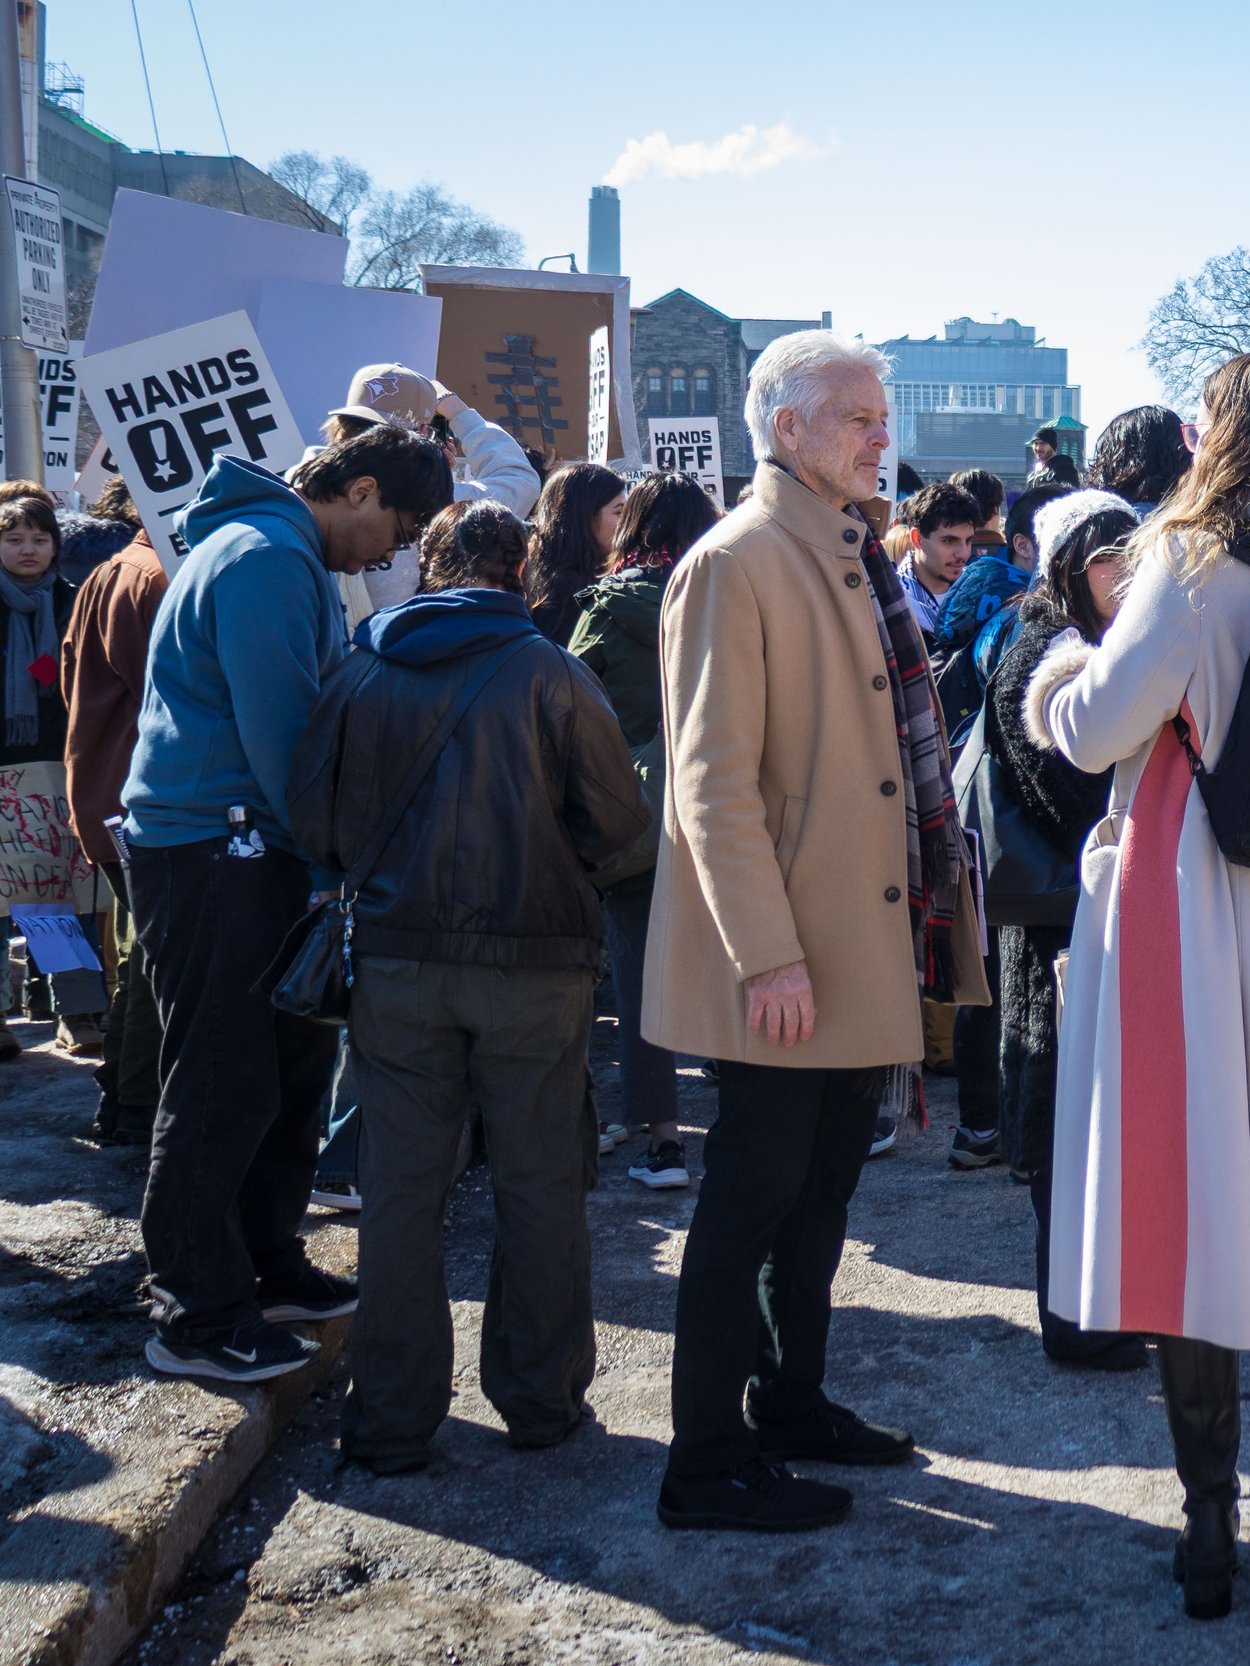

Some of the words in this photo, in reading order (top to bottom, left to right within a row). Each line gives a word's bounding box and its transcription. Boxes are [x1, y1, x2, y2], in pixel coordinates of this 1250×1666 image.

[15, 208, 60, 245] AUTHORIZED
[23, 237, 57, 270] PARKING
[32, 267, 50, 294] ONLY
[105, 348, 259, 423] HANDS
[127, 388, 277, 493] OFF
[654, 430, 711, 446] HANDS
[656, 446, 712, 472] OFF
